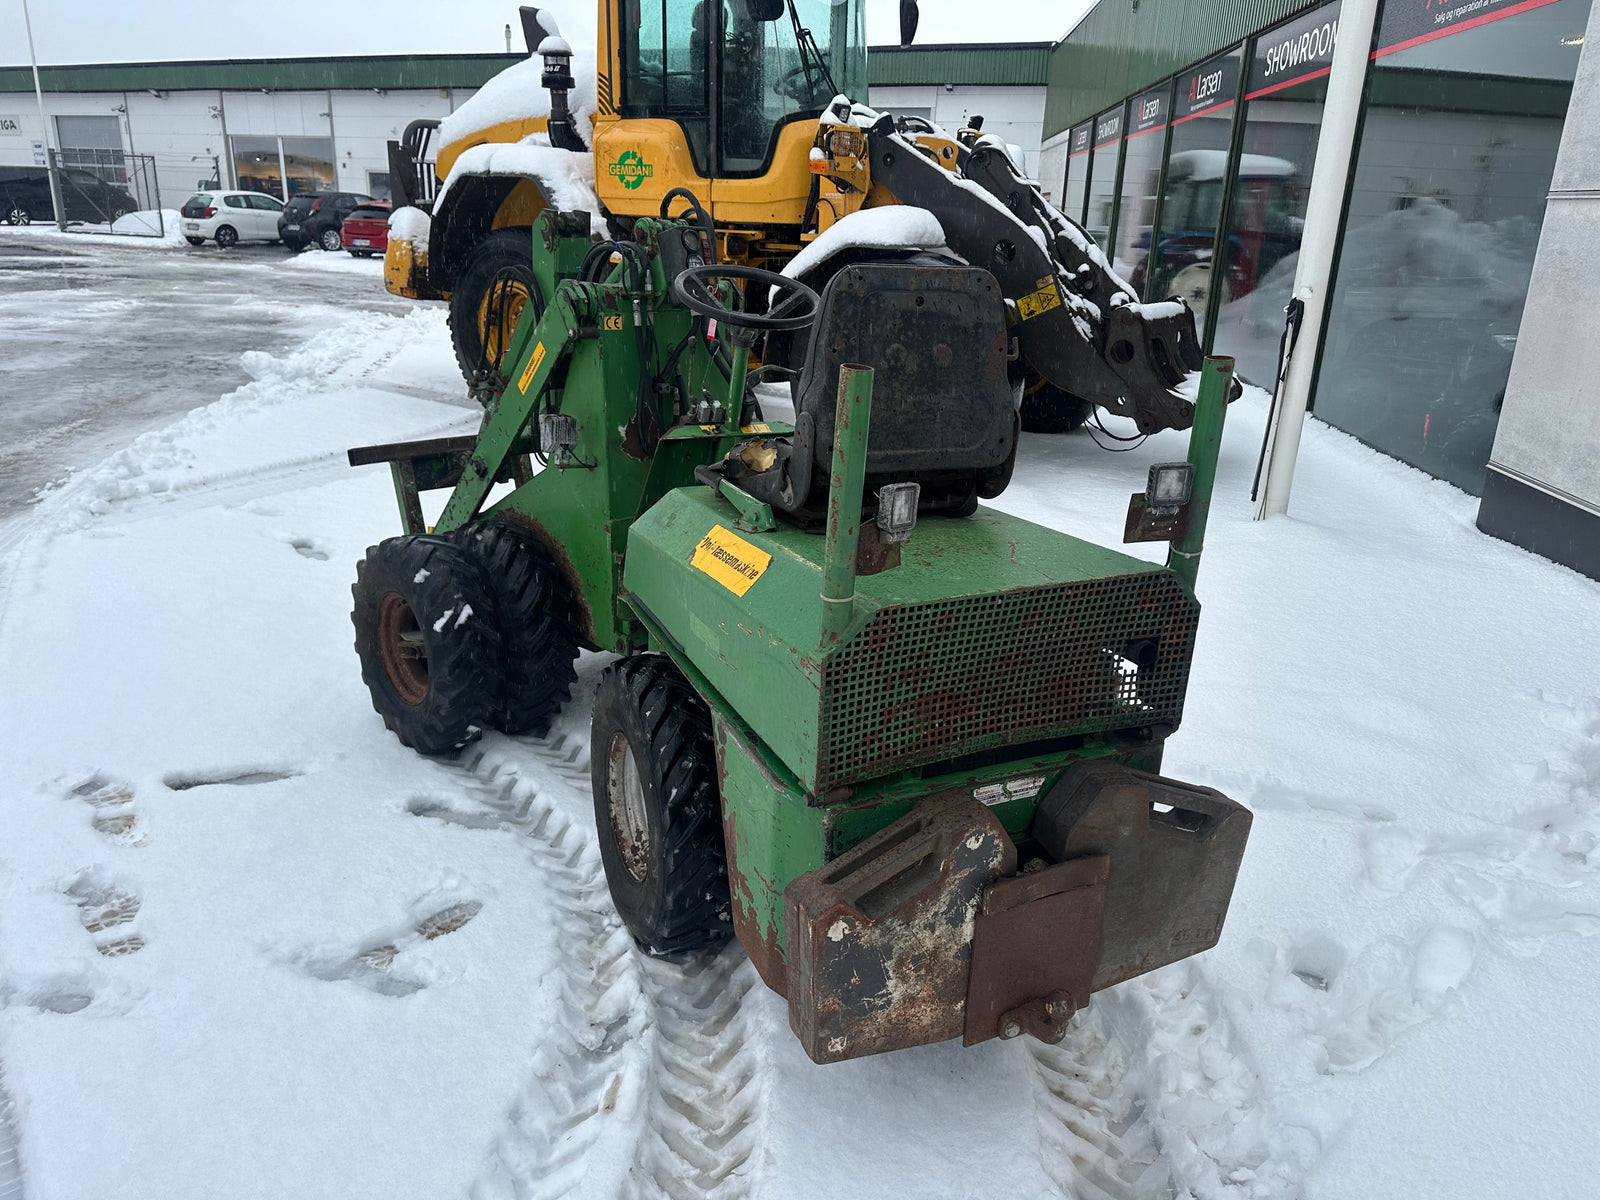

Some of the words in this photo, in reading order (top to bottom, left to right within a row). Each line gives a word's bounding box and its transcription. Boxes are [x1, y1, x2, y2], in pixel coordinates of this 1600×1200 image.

[0, 119, 17, 130] IGA
[609, 164, 649, 176] GEMIDAN
[606, 316, 620, 330] CE
